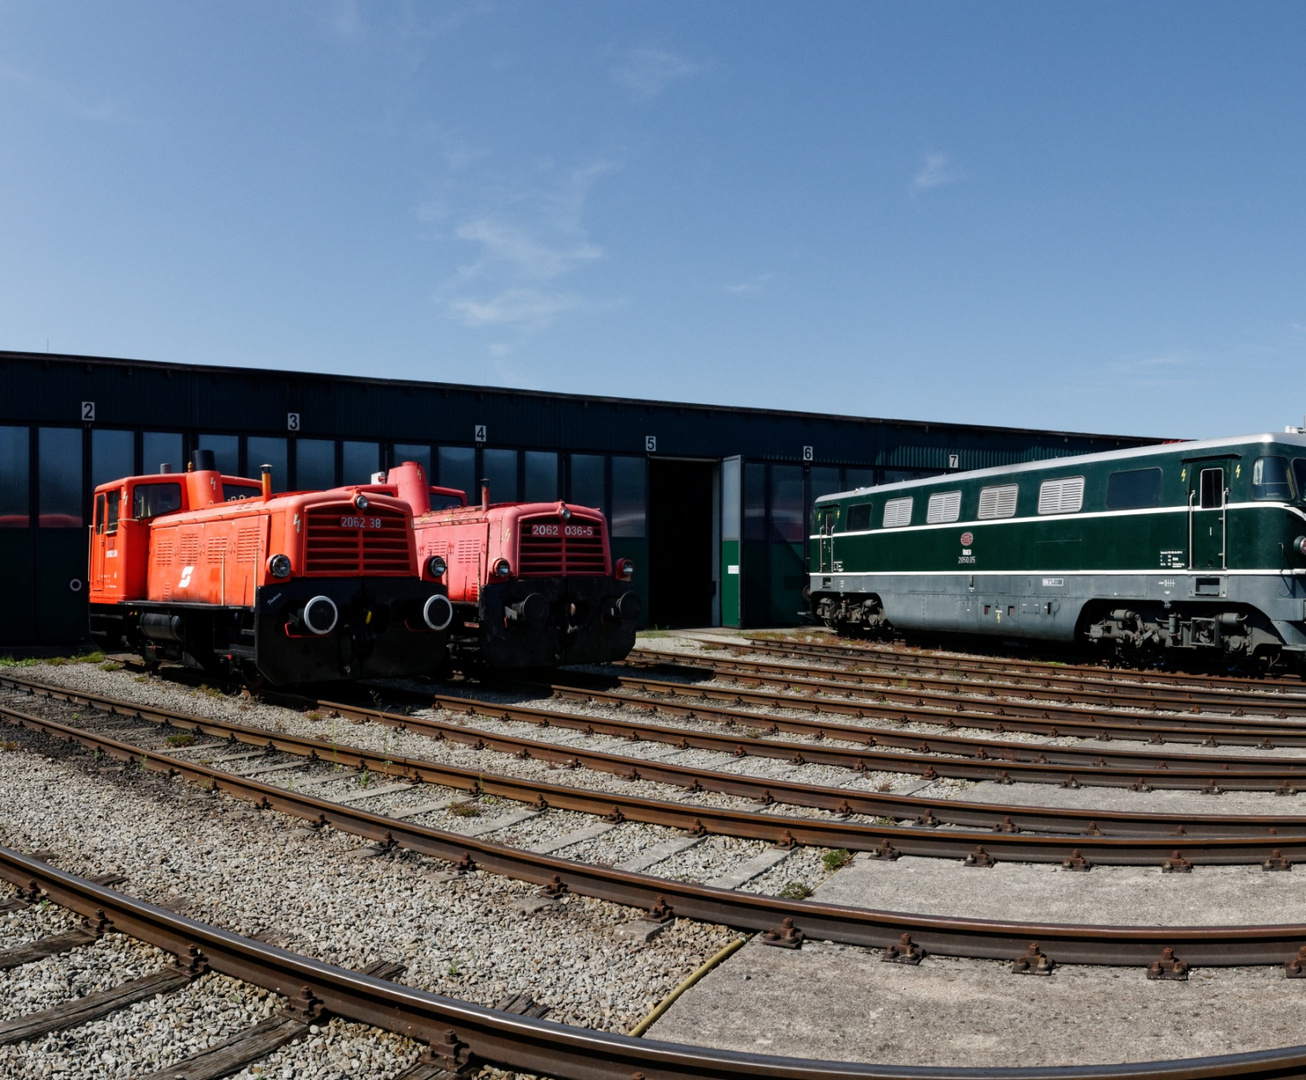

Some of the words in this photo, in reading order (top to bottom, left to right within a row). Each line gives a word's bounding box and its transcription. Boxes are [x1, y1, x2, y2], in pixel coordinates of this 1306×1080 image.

[84, 403, 93, 419] 2
[289, 415, 298, 429] 3
[477, 426, 485, 440] 4
[647, 437, 655, 450] 5
[805, 448, 811, 460] 6
[950, 456, 957, 466] 7
[532, 525, 559, 535] 2062
[564, 525, 593, 536] 036-5
